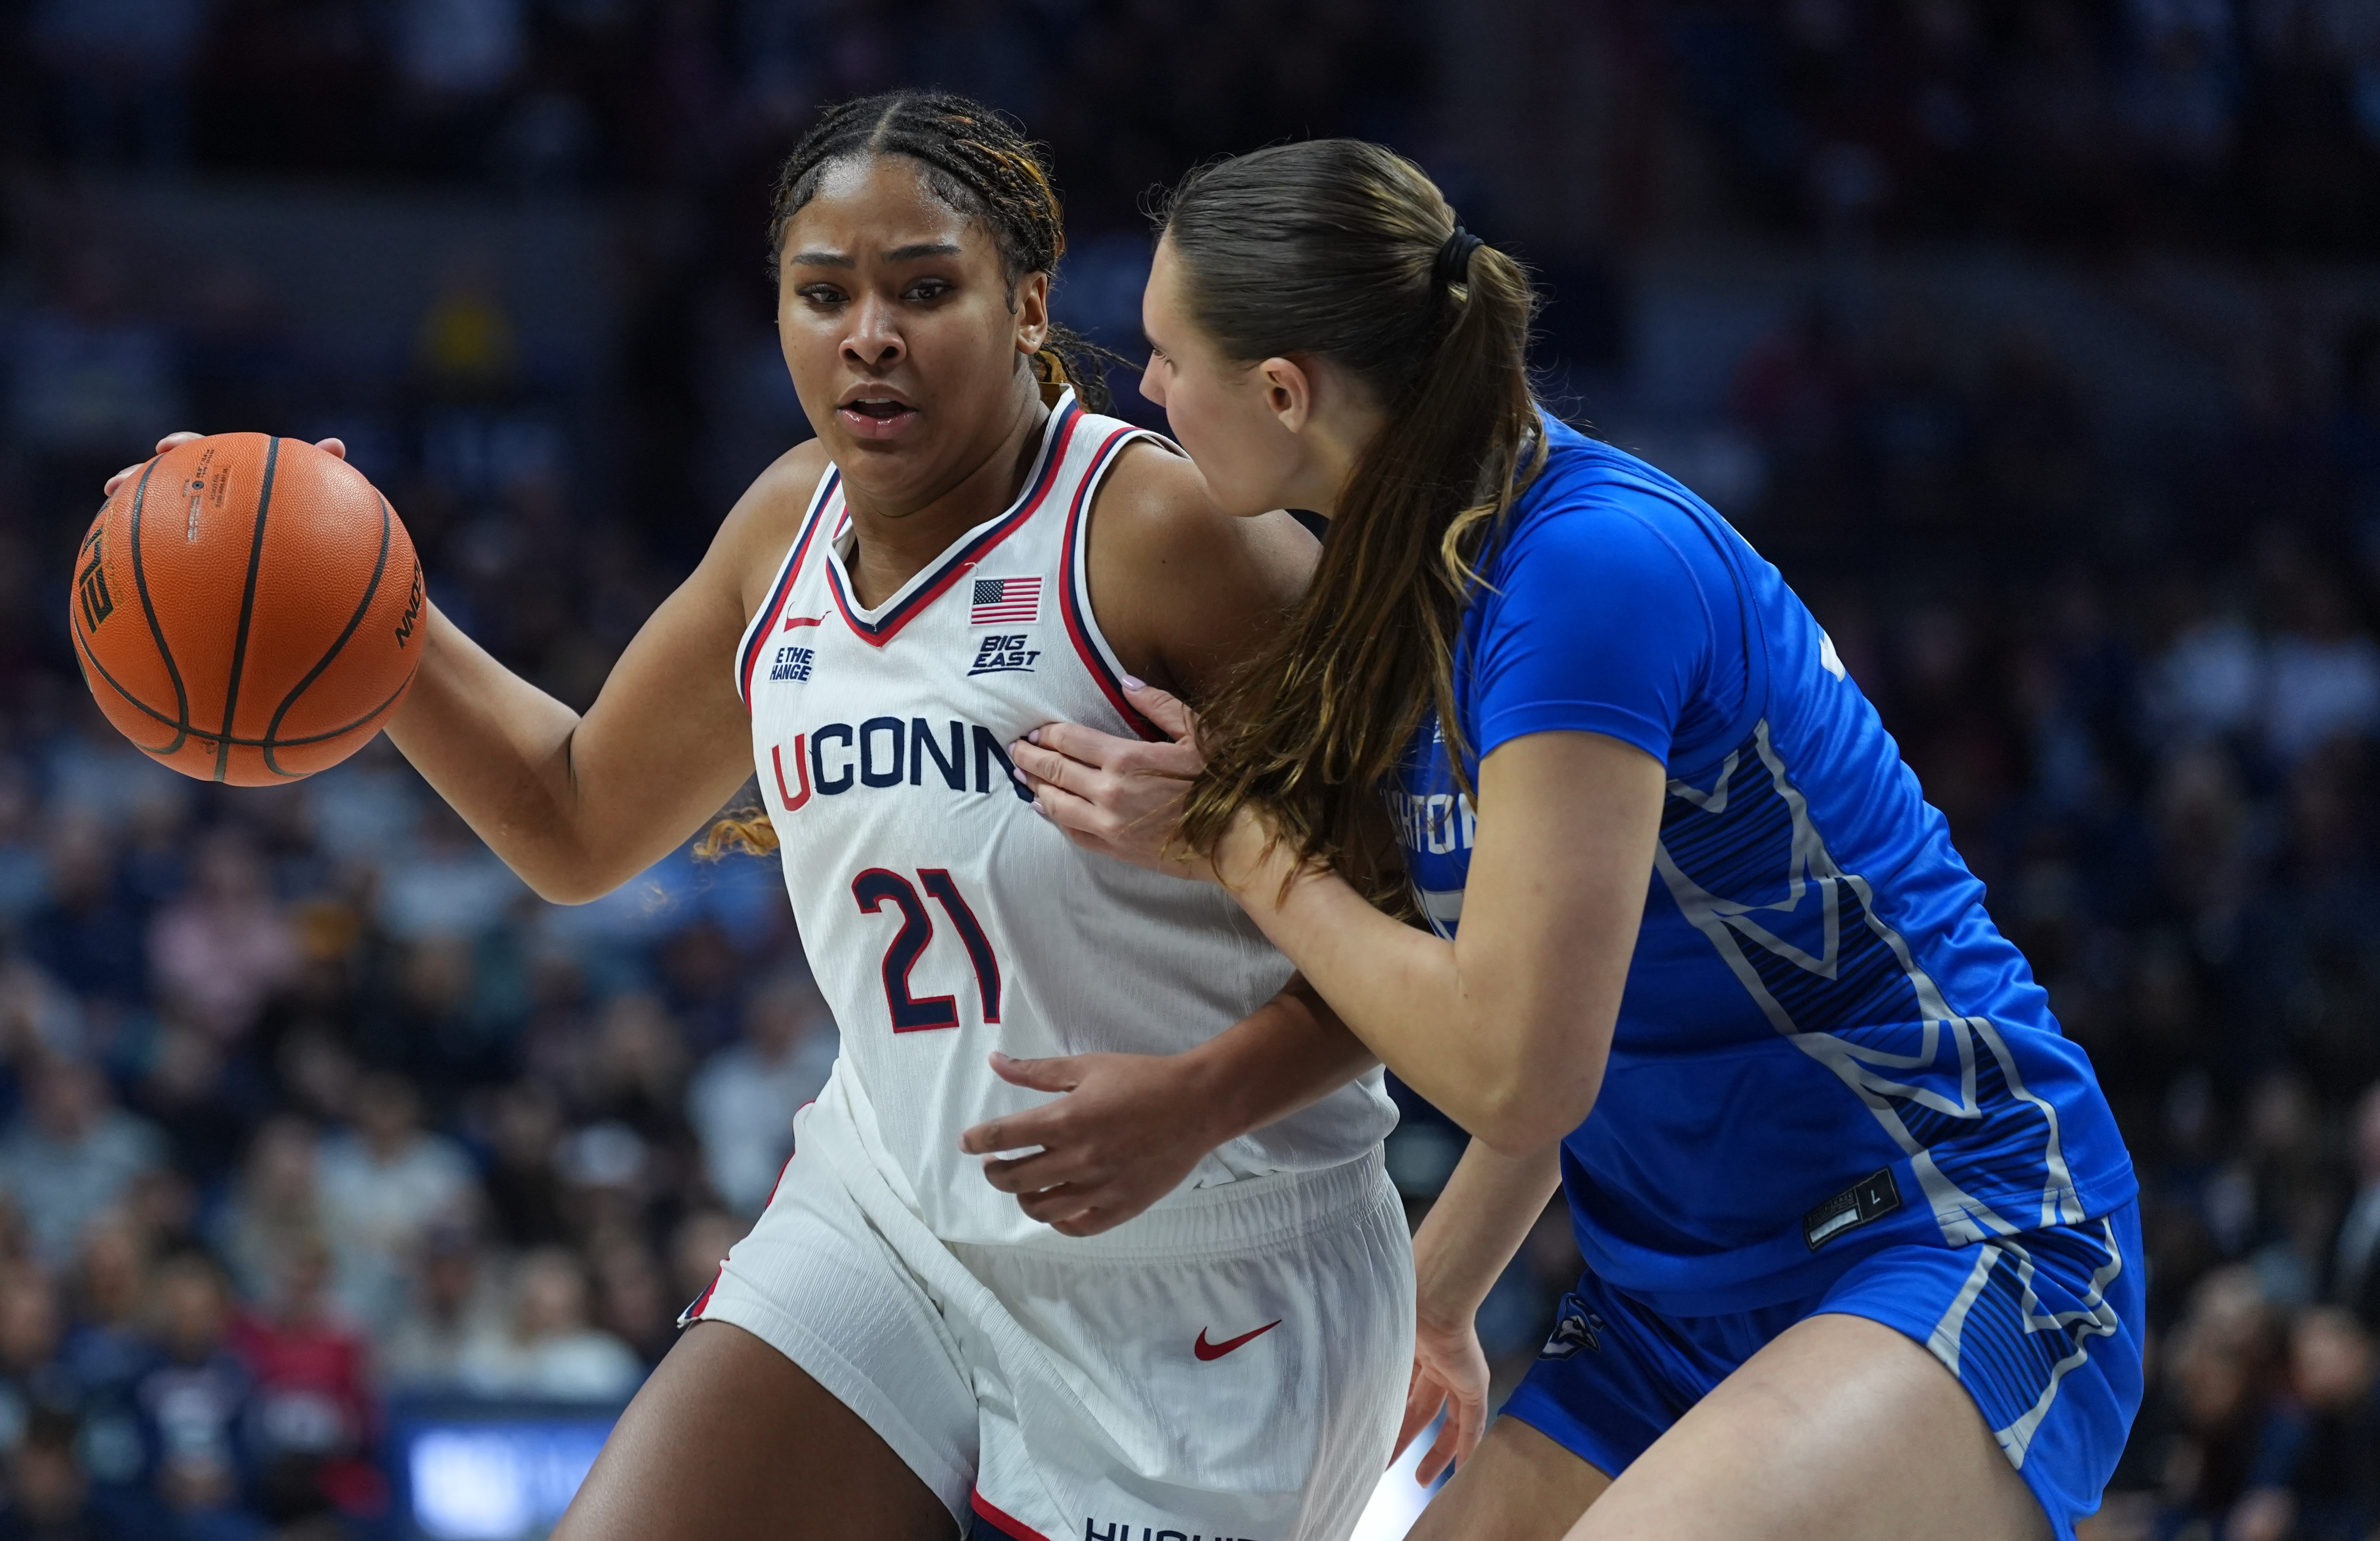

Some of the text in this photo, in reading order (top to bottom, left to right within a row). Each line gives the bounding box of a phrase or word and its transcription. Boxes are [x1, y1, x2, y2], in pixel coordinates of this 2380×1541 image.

[980, 635, 1028, 652] BIG
[775, 647, 813, 665] E THE
[972, 651, 1041, 668] EAST
[769, 664, 812, 681] HANGE
[772, 717, 1035, 814] UCONN
[851, 867, 1001, 1033] 21
[1870, 1189, 1881, 1205] L
